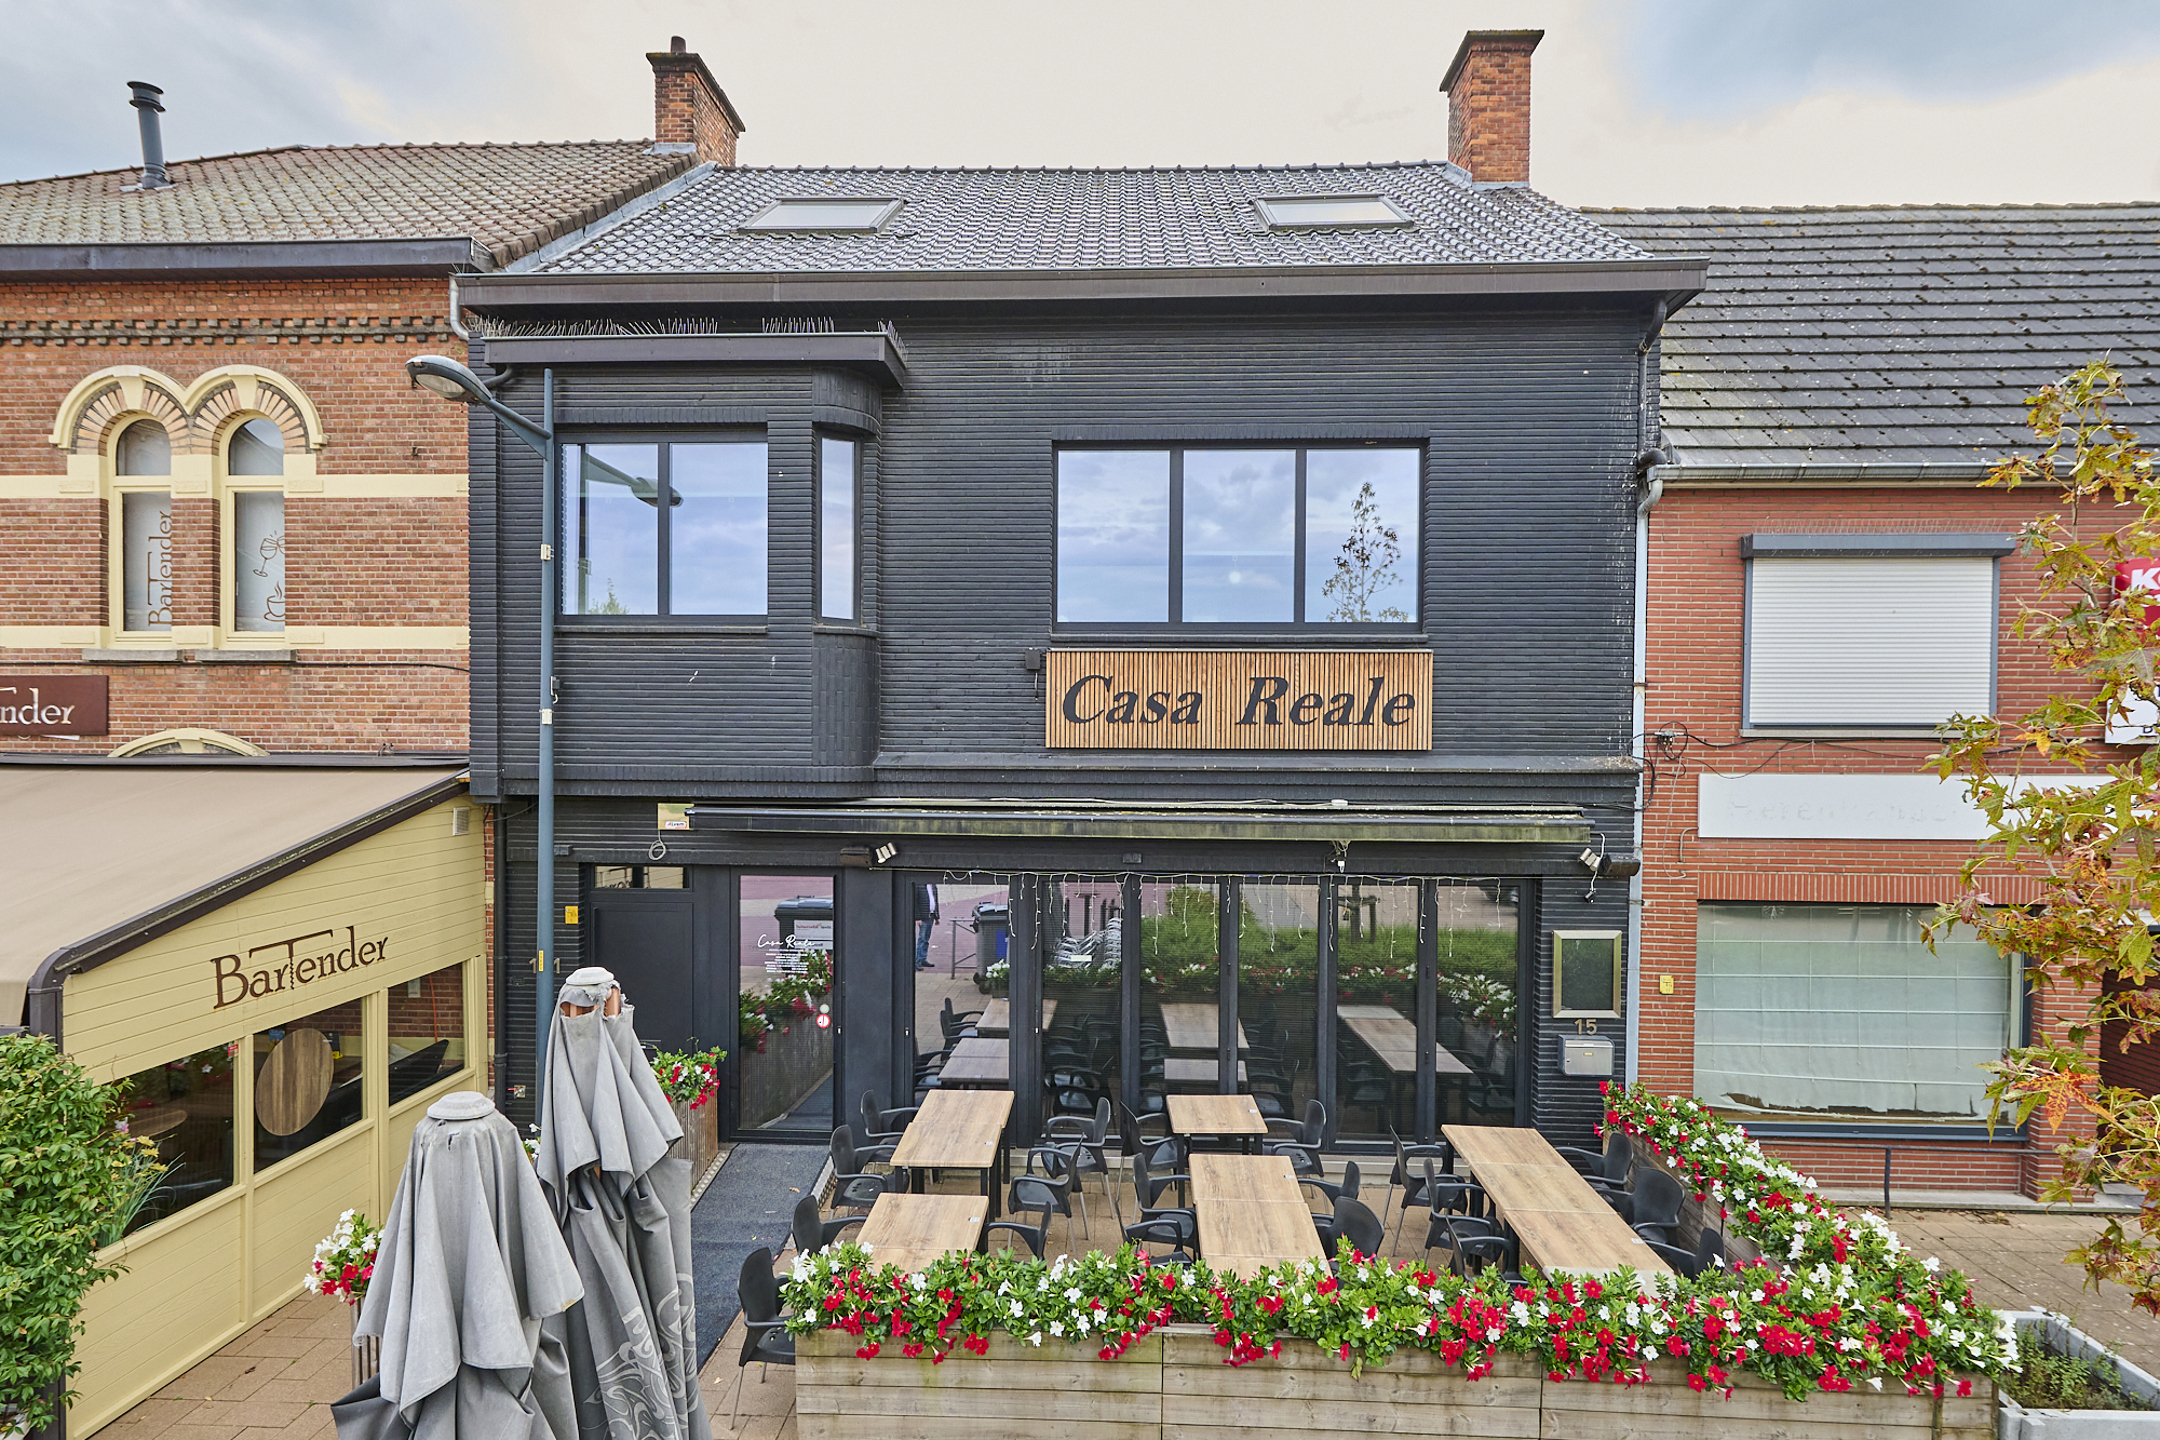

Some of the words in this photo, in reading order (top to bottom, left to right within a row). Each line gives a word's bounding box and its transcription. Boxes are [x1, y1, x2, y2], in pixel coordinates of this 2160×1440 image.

[0, 687, 76, 725] nder
[1062, 674, 1202, 725] Casa
[1235, 676, 1416, 727] Reale
[757, 933, 784, 948] Casa
[1574, 1018, 1598, 1036] 15
